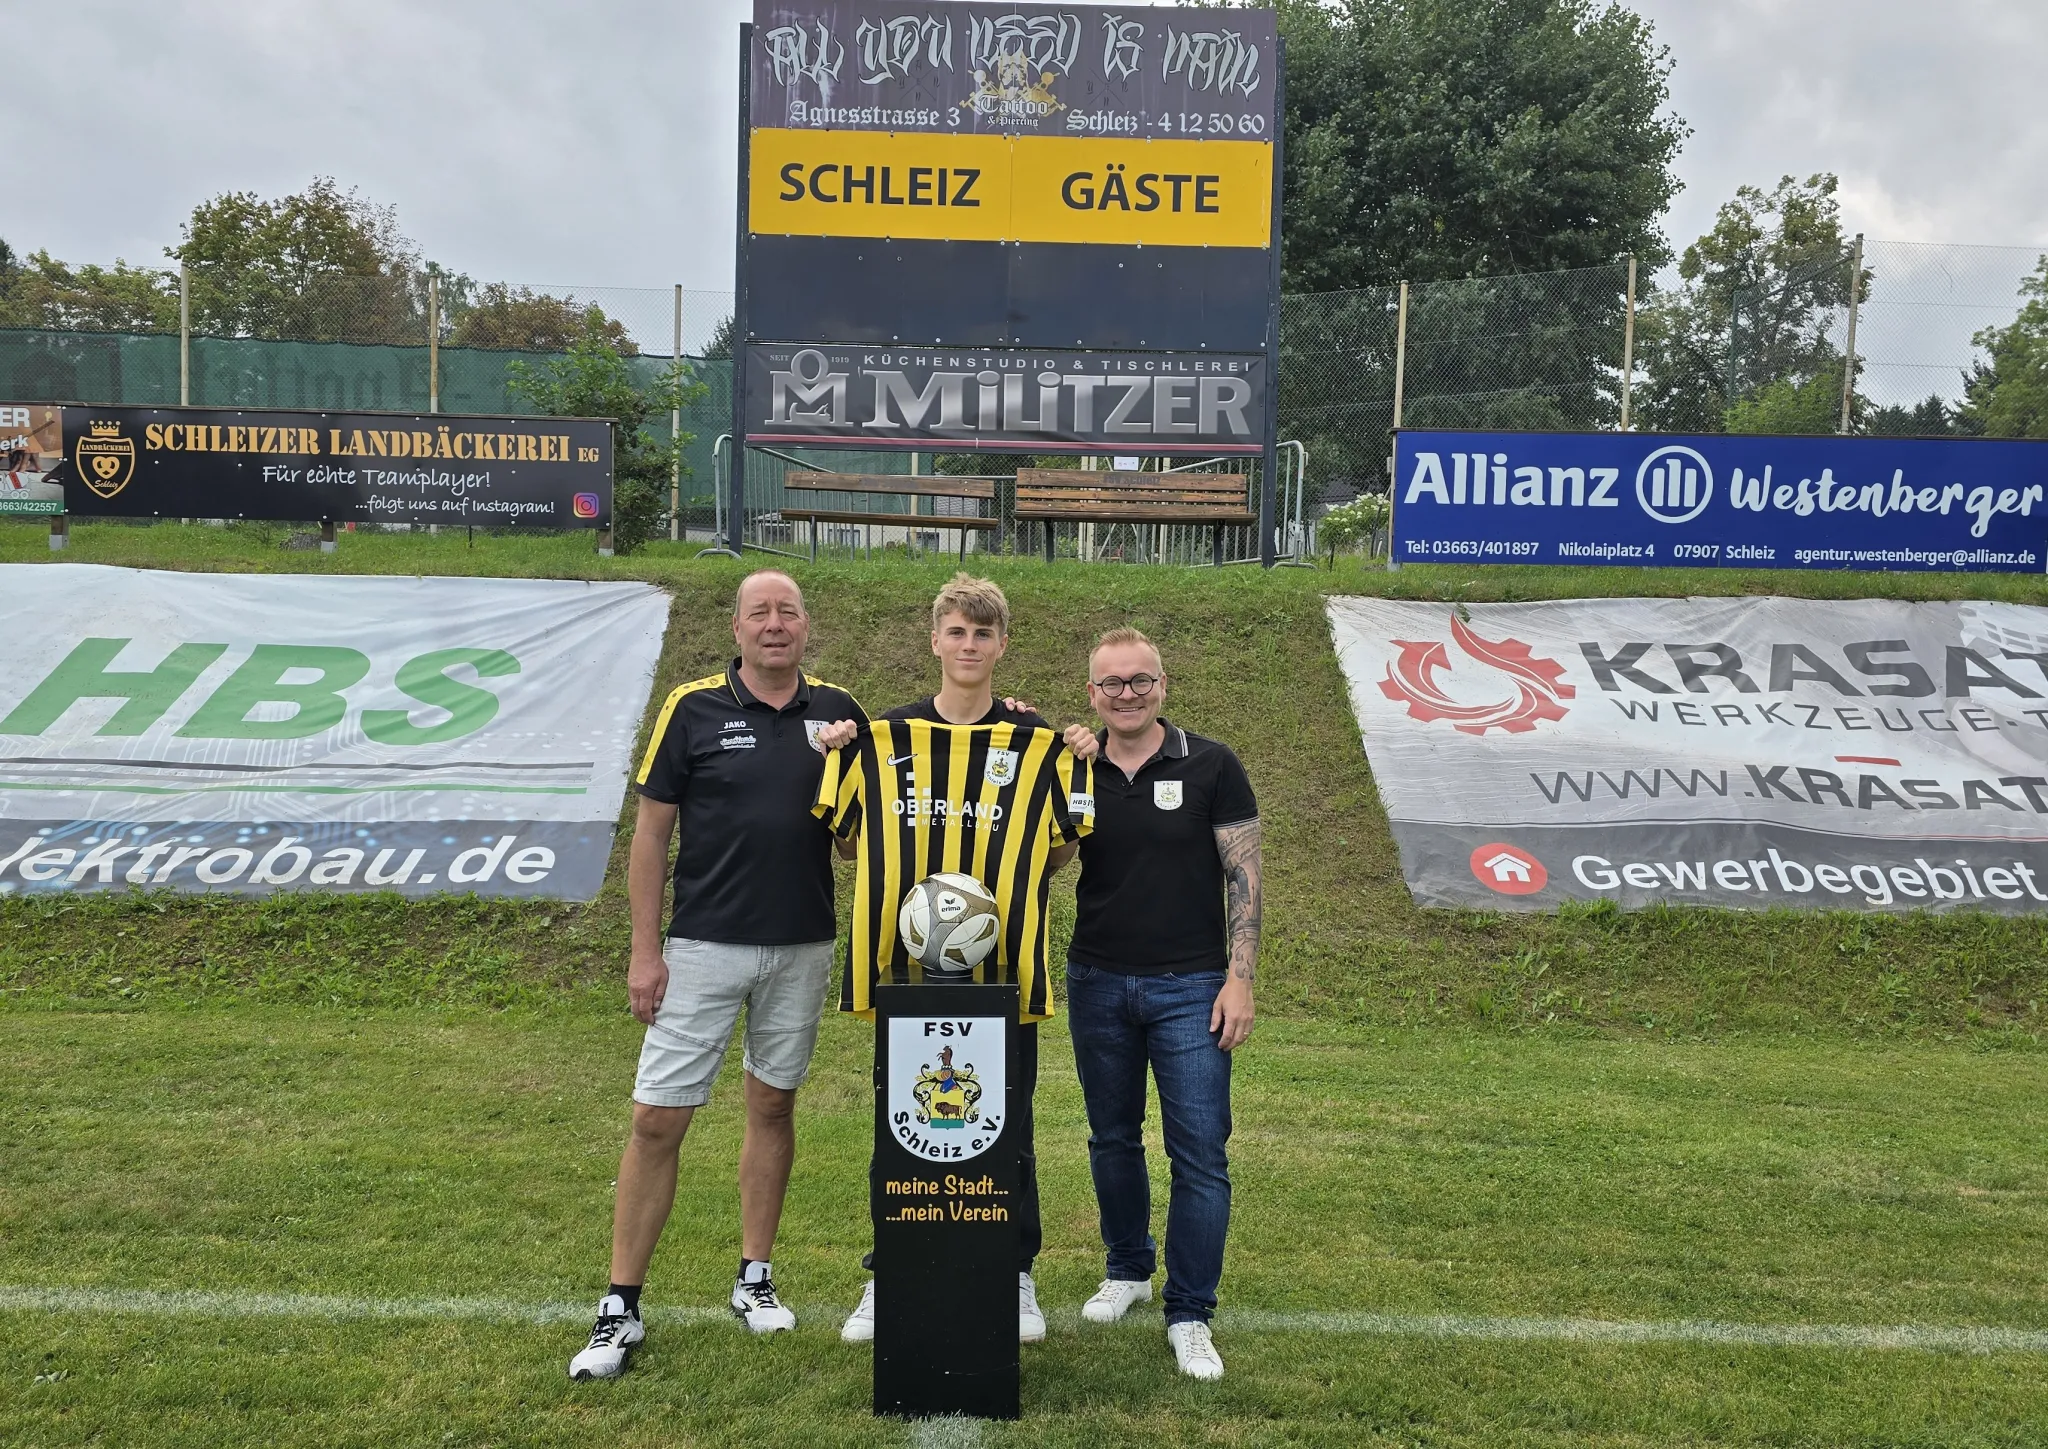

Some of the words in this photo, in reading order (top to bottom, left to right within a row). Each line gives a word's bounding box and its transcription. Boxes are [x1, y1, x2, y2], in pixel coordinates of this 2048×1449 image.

[788, 100, 940, 129] Agnesstrasse
[945, 106, 961, 127] 3
[979, 94, 1049, 115] Tattoo
[1065, 108, 1138, 137] Schleiz
[1157, 112, 1173, 134] 4
[1178, 112, 1202, 134] 12
[1208, 112, 1234, 134] 50
[1238, 112, 1265, 135] 60
[779, 162, 981, 207] SCHLEIZ
[1060, 163, 1220, 213] GÄSTE
[863, 353, 1057, 370] KÜCHENSTUDIO
[1073, 359, 1084, 370] &
[1101, 360, 1250, 373] TISCHLEREI
[145, 423, 320, 454] SCHLEIZER
[329, 425, 571, 462] LANDBÄCKEREI
[577, 447, 600, 464] EG
[262, 464, 301, 484] Für
[306, 464, 357, 485] echte
[362, 468, 492, 496] Teamplayer!
[408, 499, 438, 511] uns
[441, 497, 470, 515] auf
[472, 499, 555, 516] Instagram!
[1403, 451, 1619, 507] Allianz
[1729, 464, 2044, 538] Westenberger
[1405, 540, 1430, 554] Tel:
[1432, 540, 1540, 557] 03663/401897
[1558, 542, 1642, 560] Nikolaiplatz
[1645, 544, 1655, 557] 4
[1673, 544, 1720, 559] 07907
[1725, 545, 1776, 560] Schleiz
[1794, 547, 2036, 567] agentur.westenberger@allianz.de
[0, 637, 521, 746] HBS
[723, 720, 747, 730] JAKO
[891, 799, 1003, 821] OBERLAND
[1572, 848, 2048, 905] Gewerbegebiet
[941, 905, 961, 913] erima
[924, 1021, 973, 1037] FSV
[893, 1110, 963, 1159] Schleiz
[885, 1176, 940, 1195] meine
[944, 1174, 1009, 1196] Stadt...
[885, 1203, 944, 1222] ...mein
[949, 1200, 1009, 1222] Verein
